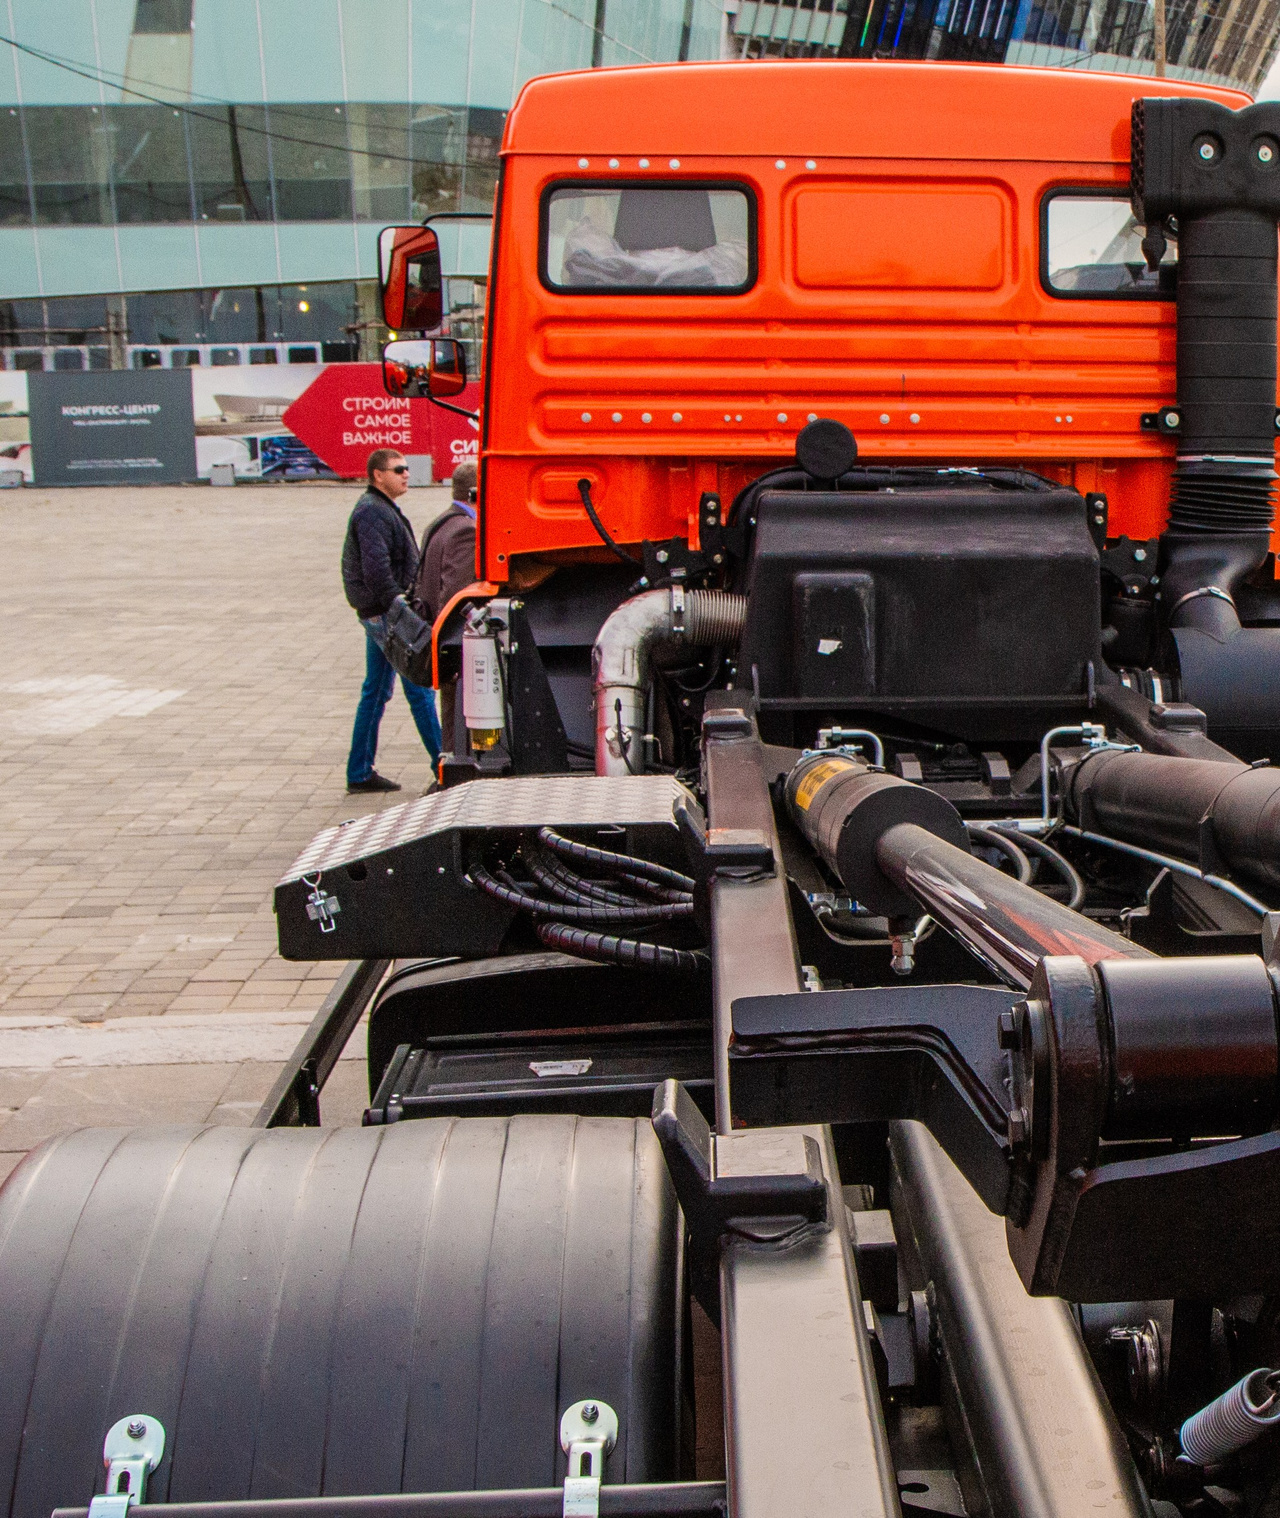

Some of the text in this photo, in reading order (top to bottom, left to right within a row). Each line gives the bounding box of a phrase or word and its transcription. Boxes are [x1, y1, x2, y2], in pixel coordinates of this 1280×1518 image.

[61, 404, 160, 416] КОНГРЕСС-ЦЕНТР
[342, 397, 410, 411] СТРОИМ
[354, 414, 411, 428] САМОЕ
[343, 431, 411, 445] ВАЖНОЕ
